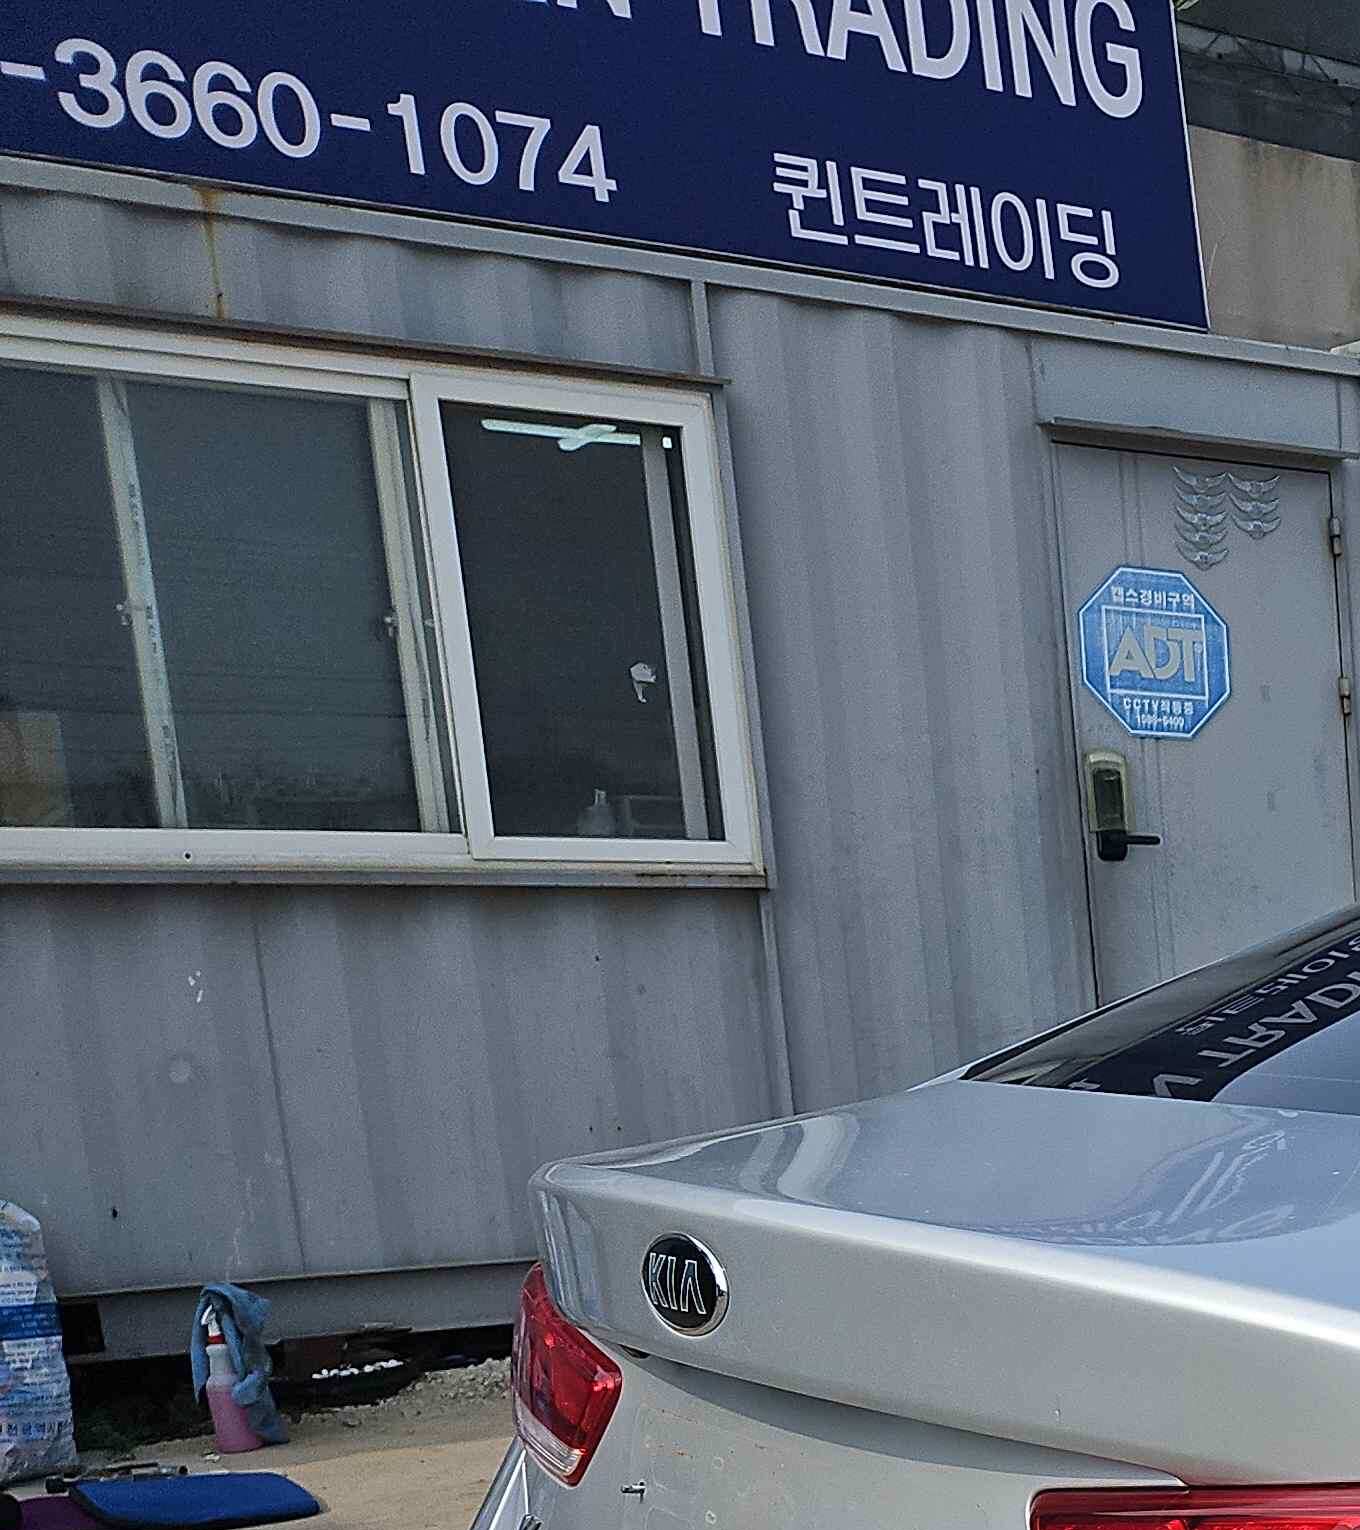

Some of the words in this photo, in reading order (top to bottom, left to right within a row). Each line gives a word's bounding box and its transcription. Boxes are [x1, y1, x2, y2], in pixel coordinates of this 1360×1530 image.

[772, 152, 1119, 288] 퀸트레이딩
[1108, 624, 1205, 682] ADT
[648, 1251, 707, 1315] KIA
